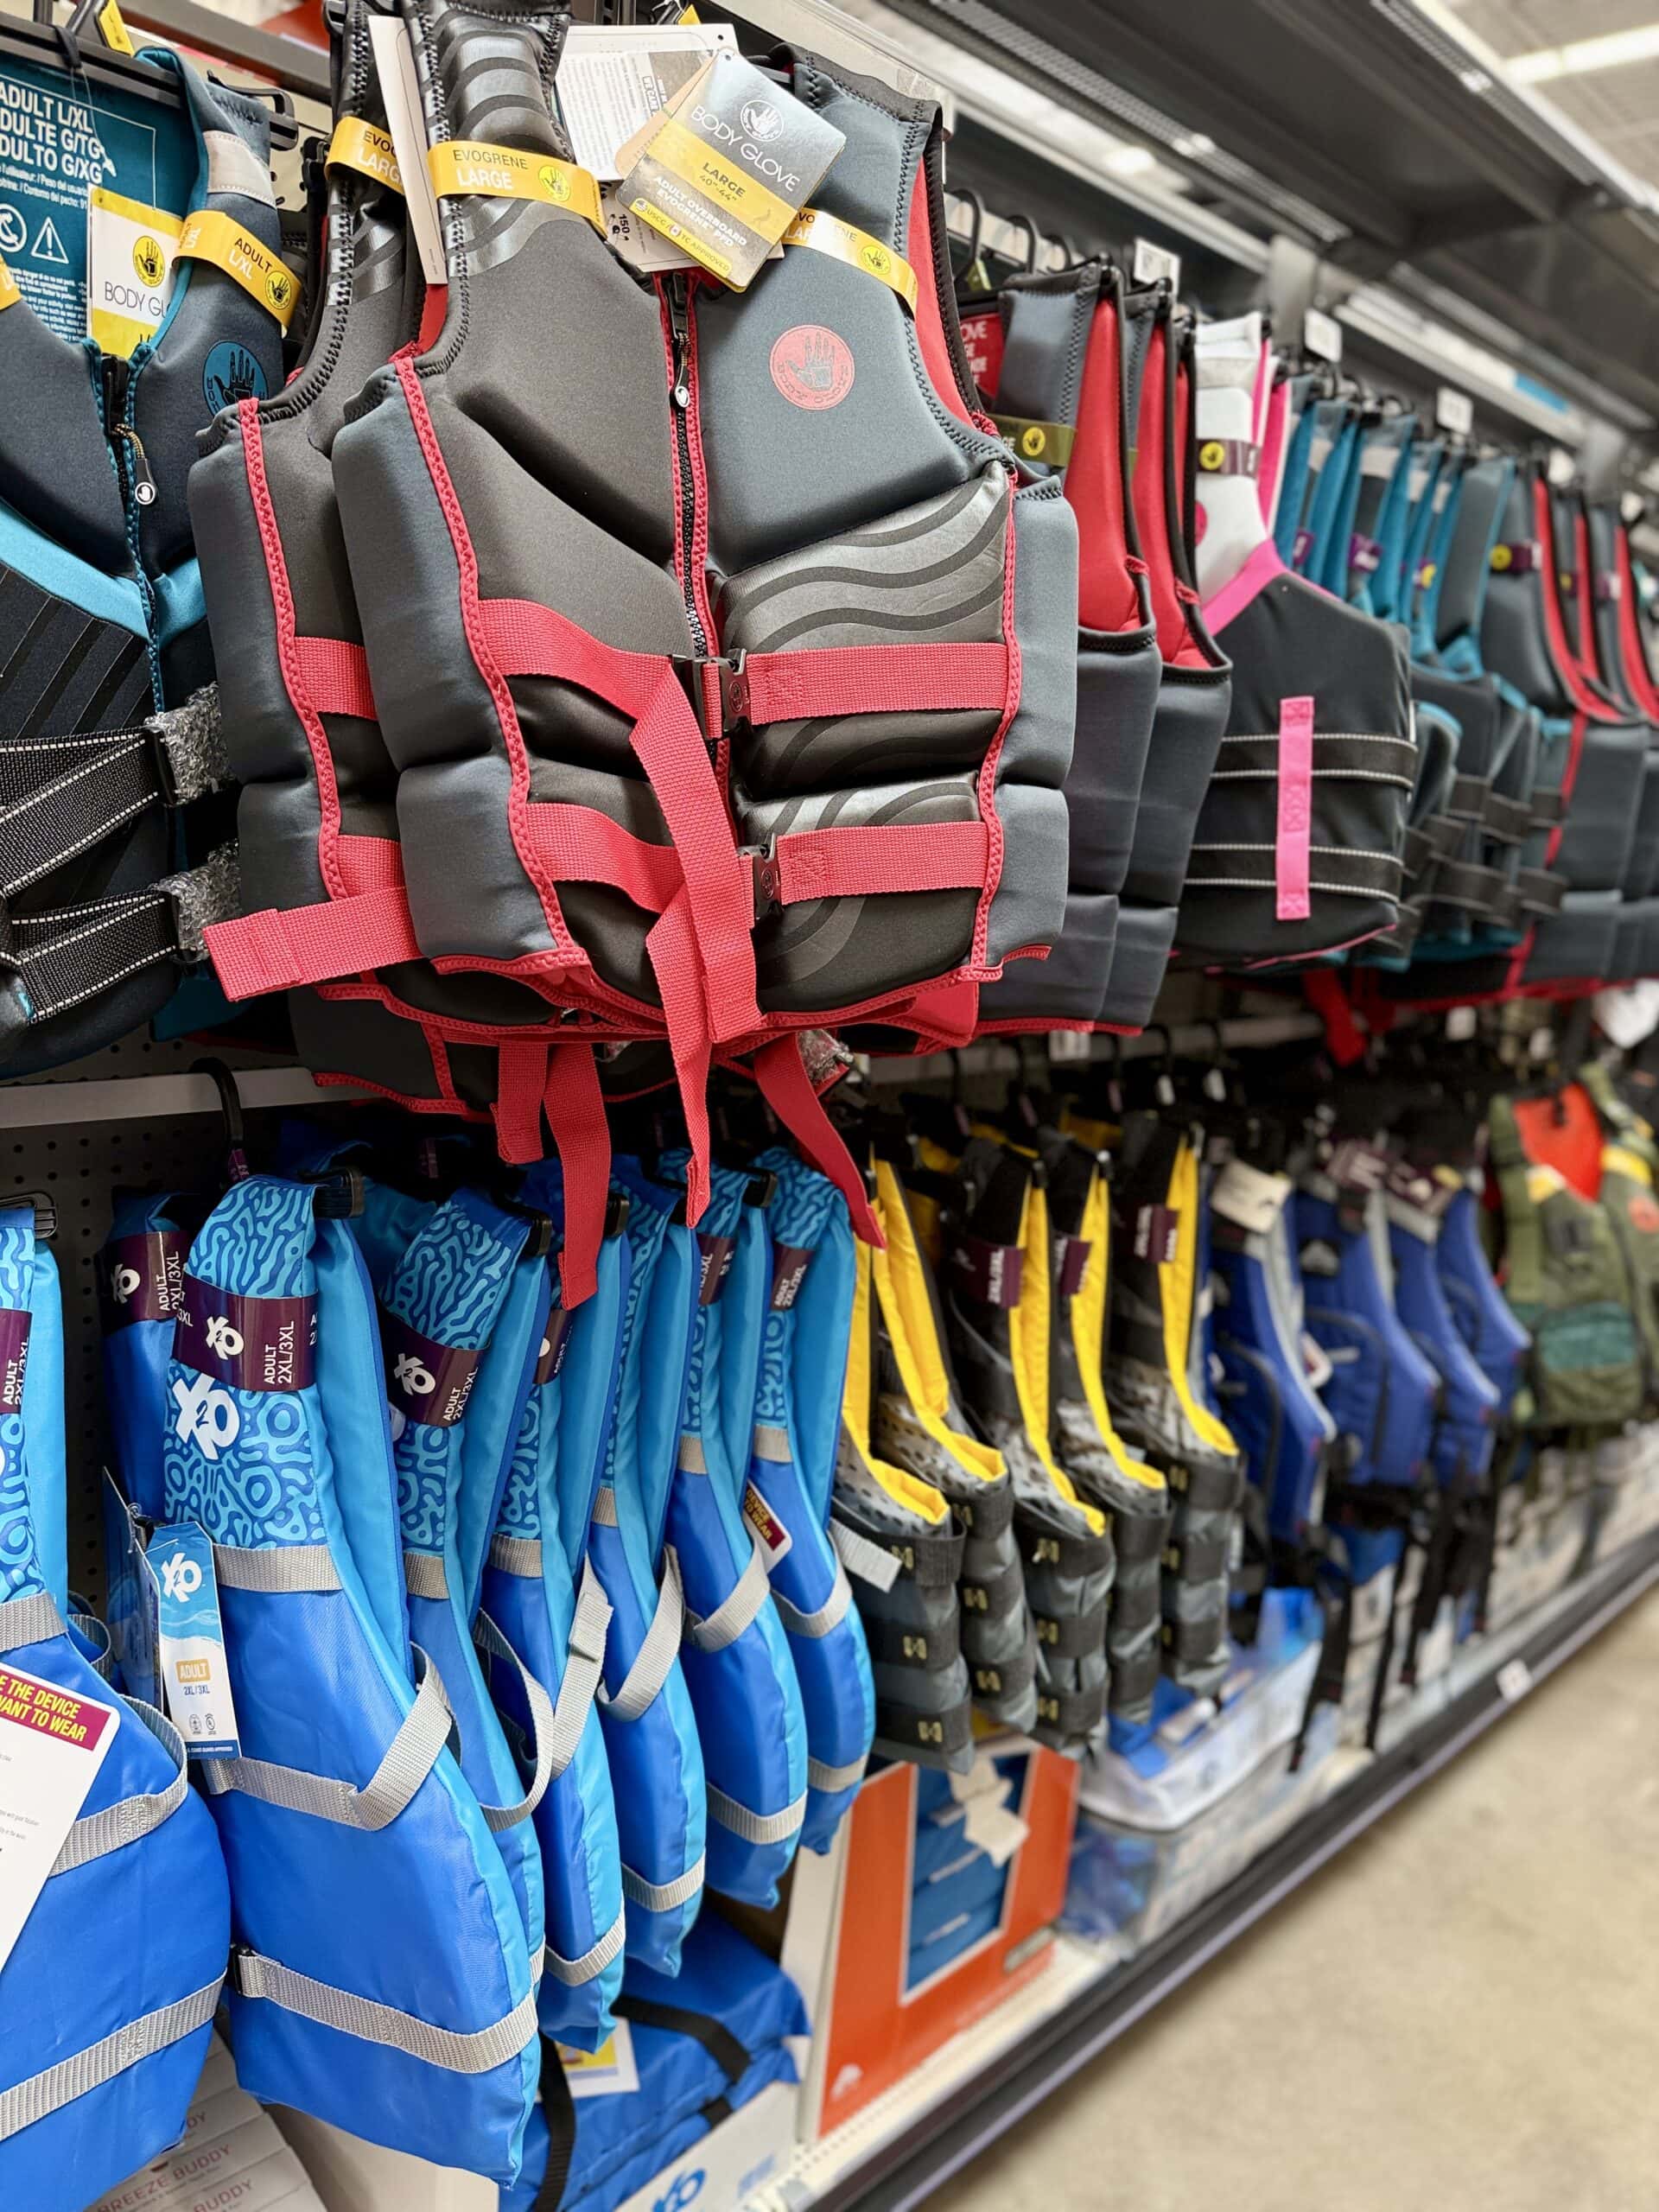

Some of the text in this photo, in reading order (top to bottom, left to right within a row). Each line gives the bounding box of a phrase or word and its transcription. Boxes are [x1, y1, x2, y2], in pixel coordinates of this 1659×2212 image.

[0, 107, 102, 160] DULTE G/TG
[58, 101, 92, 134] L/XL
[0, 134, 57, 172] DULTO
[61, 154, 103, 184] G/XG
[358, 144, 403, 185] LARG
[453, 149, 529, 170] EVOGRENE
[691, 105, 744, 146] BODY
[741, 143, 800, 192] GLOVE
[455, 167, 513, 190] LARGE
[702, 162, 747, 198] LARGE
[619, 214, 631, 233] 150
[654, 175, 687, 201] ADULT
[688, 200, 747, 246] OVERBOARD
[228, 250, 252, 281] L/XL
[234, 238, 272, 274] ADULT
[105, 281, 145, 312] BODY
[156, 1274, 171, 1312] ADULT
[264, 1344, 276, 1384] ADULT
[277, 1320, 294, 1384] 2XL/3XL
[3, 1359, 18, 1406] ADULT
[453, 1366, 479, 1421] 2XL/3XL
[442, 1387, 461, 1421] ADULT
[180, 1662, 207, 1679] ADULT
[8, 1679, 35, 1702] THE
[33, 1689, 82, 1719] DEVICE
[30, 1707, 50, 1727] TO
[48, 1715, 88, 1743] WEAR
[173, 2144, 232, 2181] BUDDY
[193, 2178, 253, 2212] BUDDY
